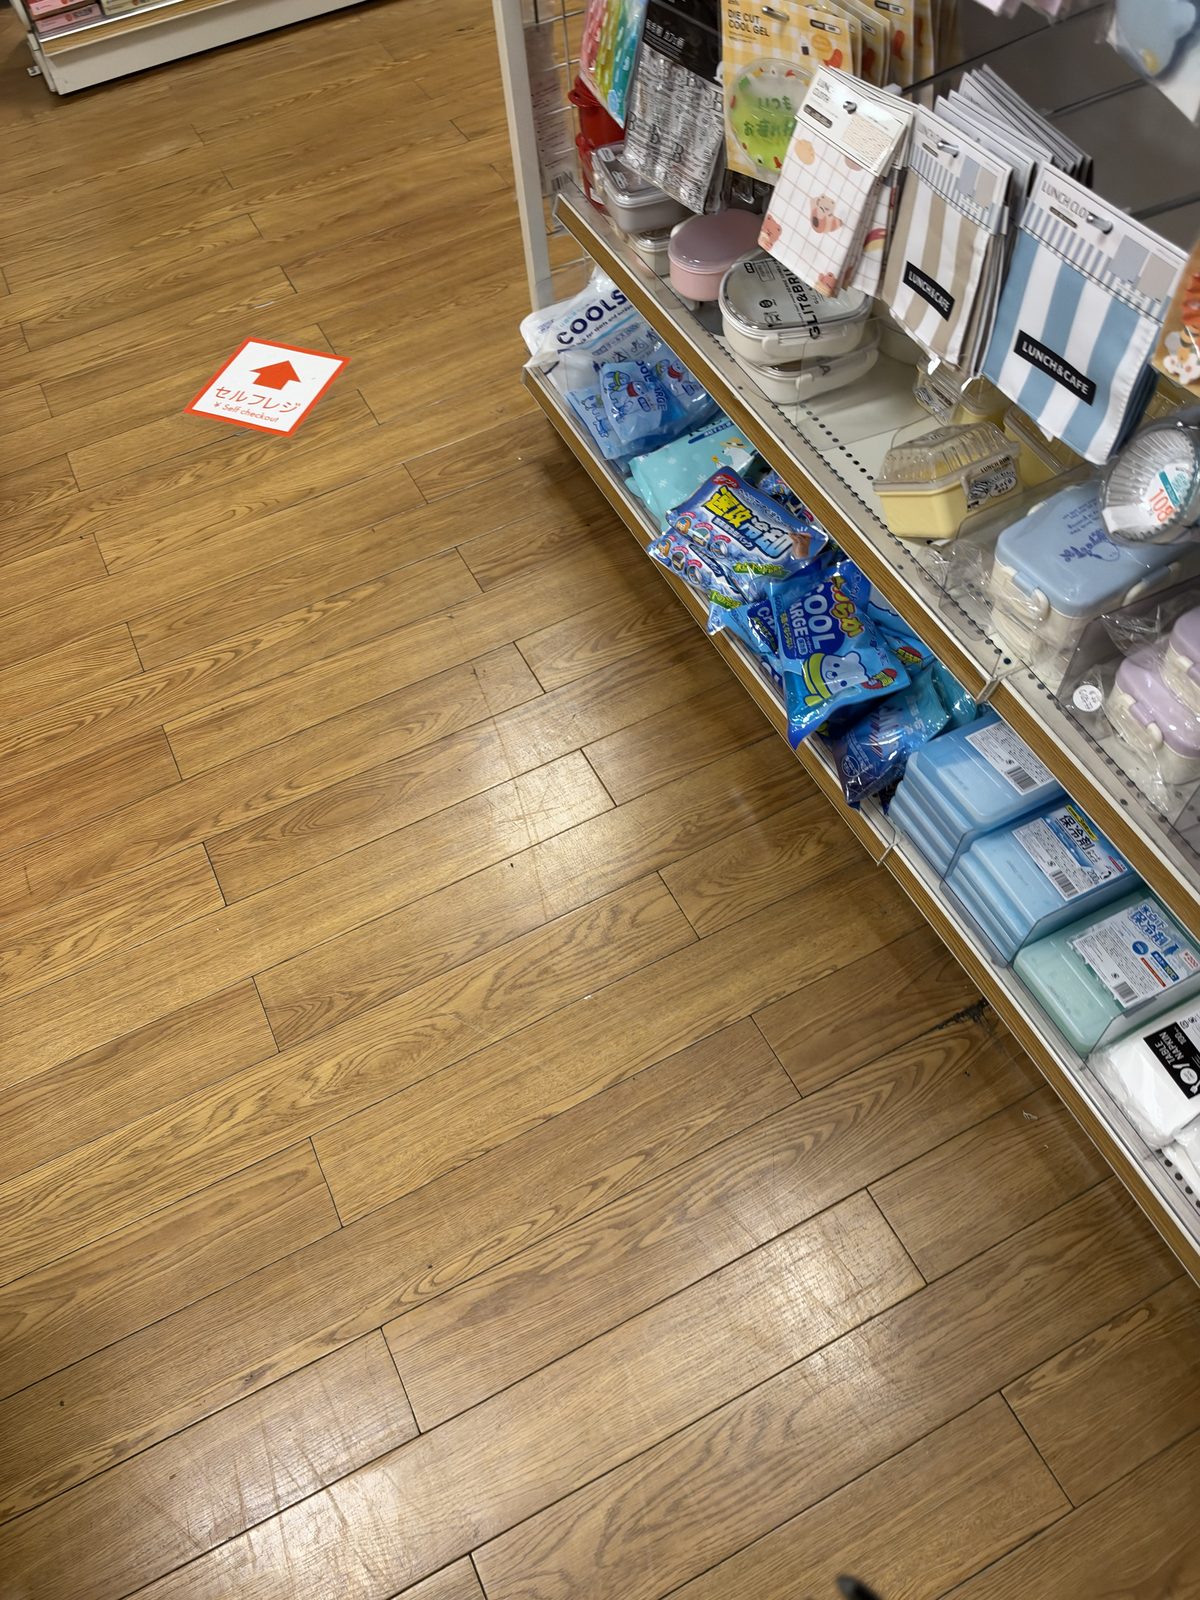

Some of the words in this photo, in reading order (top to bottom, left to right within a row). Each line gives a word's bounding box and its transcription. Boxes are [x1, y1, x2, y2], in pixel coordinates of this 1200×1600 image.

[728, 9, 741, 19] DIE
[743, 13, 760, 24] CUT
[728, 20, 751, 33] COOL
[752, 24, 770, 37] GEL
[1040, 181, 1070, 210] LUNCH
[908, 270, 951, 313] LUNCH&CAFE
[1021, 340, 1090, 395] LUNCH&CAFE
[214, 386, 301, 413] セルフレジ
[222, 404, 241, 415] Self
[240, 408, 280, 424] checkout
[1059, 814, 1095, 851] 保冷剤
[1130, 910, 1170, 947] 保冷剤
[1154, 1040, 1176, 1066] TABLE
[1159, 1031, 1185, 1061] NAPKIN
